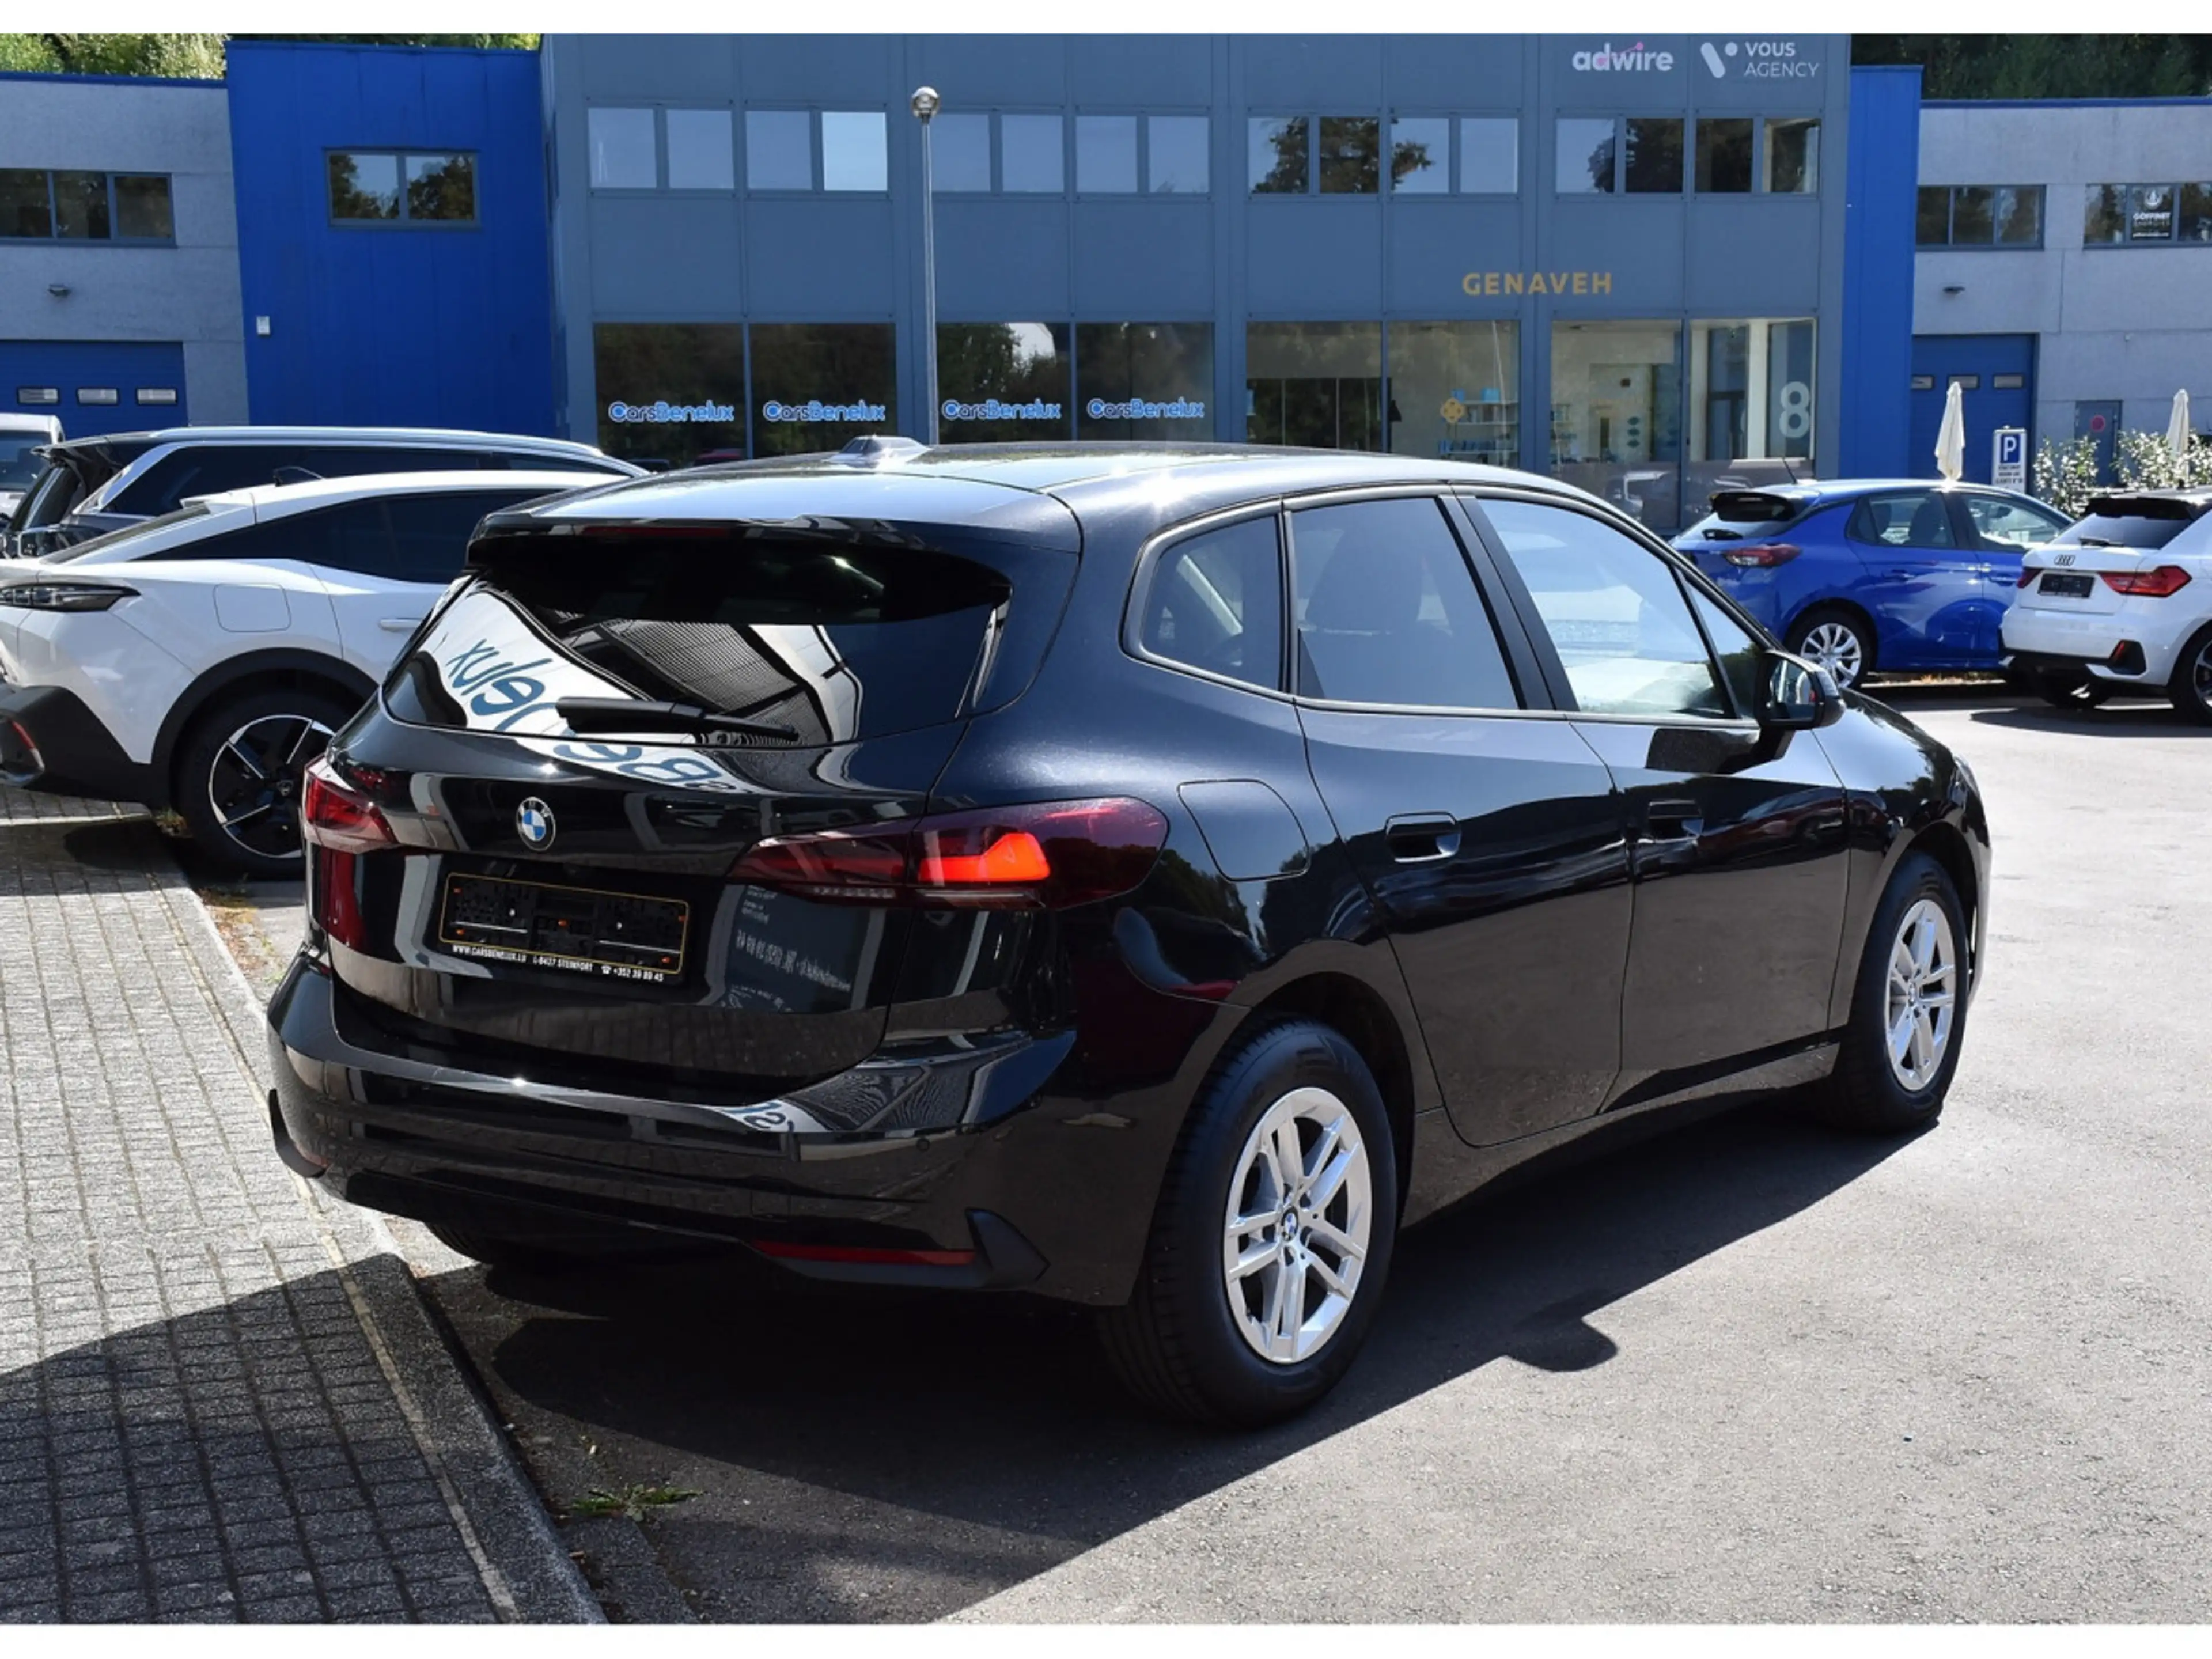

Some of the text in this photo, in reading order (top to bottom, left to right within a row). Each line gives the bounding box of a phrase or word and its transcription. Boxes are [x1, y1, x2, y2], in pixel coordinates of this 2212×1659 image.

[1572, 42, 1673, 71] adwire
[1745, 41, 1796, 56] VOUS
[1744, 62, 1820, 77] AGENCY
[1463, 272, 1611, 295] GENAVEH
[609, 400, 734, 422] CarsBenelux
[763, 400, 885, 422] CarsBenelux
[942, 398, 1061, 420] CarsBenelux
[1086, 396, 1205, 419] CarsBenelux
[1779, 381, 1810, 438] 8
[2003, 436, 2017, 461] P
